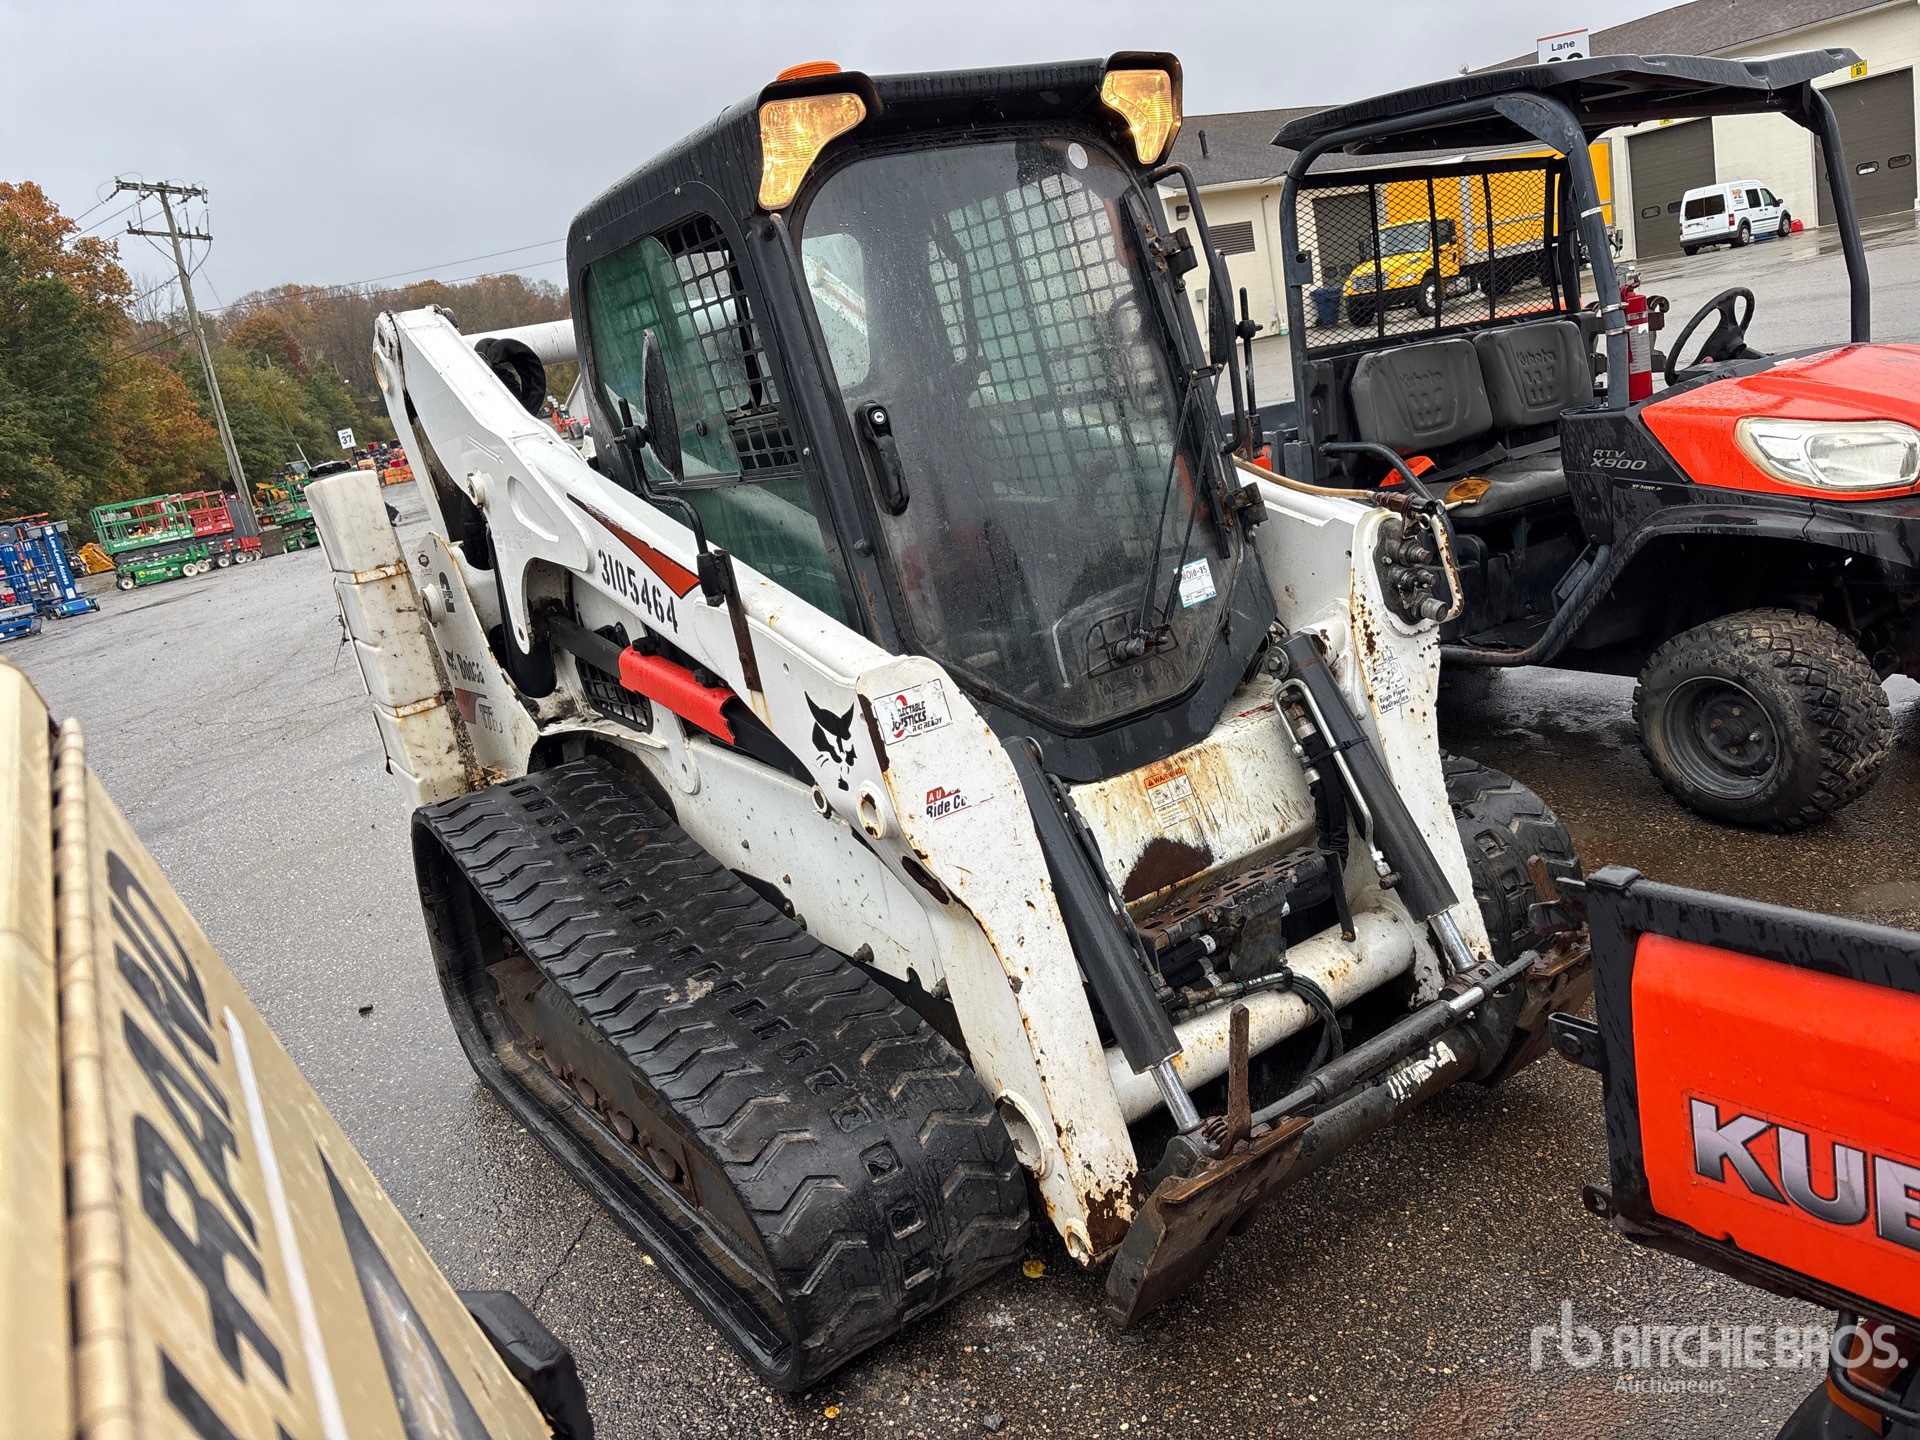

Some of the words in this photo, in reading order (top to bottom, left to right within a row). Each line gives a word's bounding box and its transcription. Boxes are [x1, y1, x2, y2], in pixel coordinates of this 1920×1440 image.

[1551, 40, 1576, 52] Lane
[1855, 67, 1862, 75] B
[341, 434, 352, 445] 37
[1593, 449, 1626, 458] RTV
[1590, 457, 1648, 471] X900
[598, 549, 680, 634] 3105464
[926, 800, 951, 818] Ride
